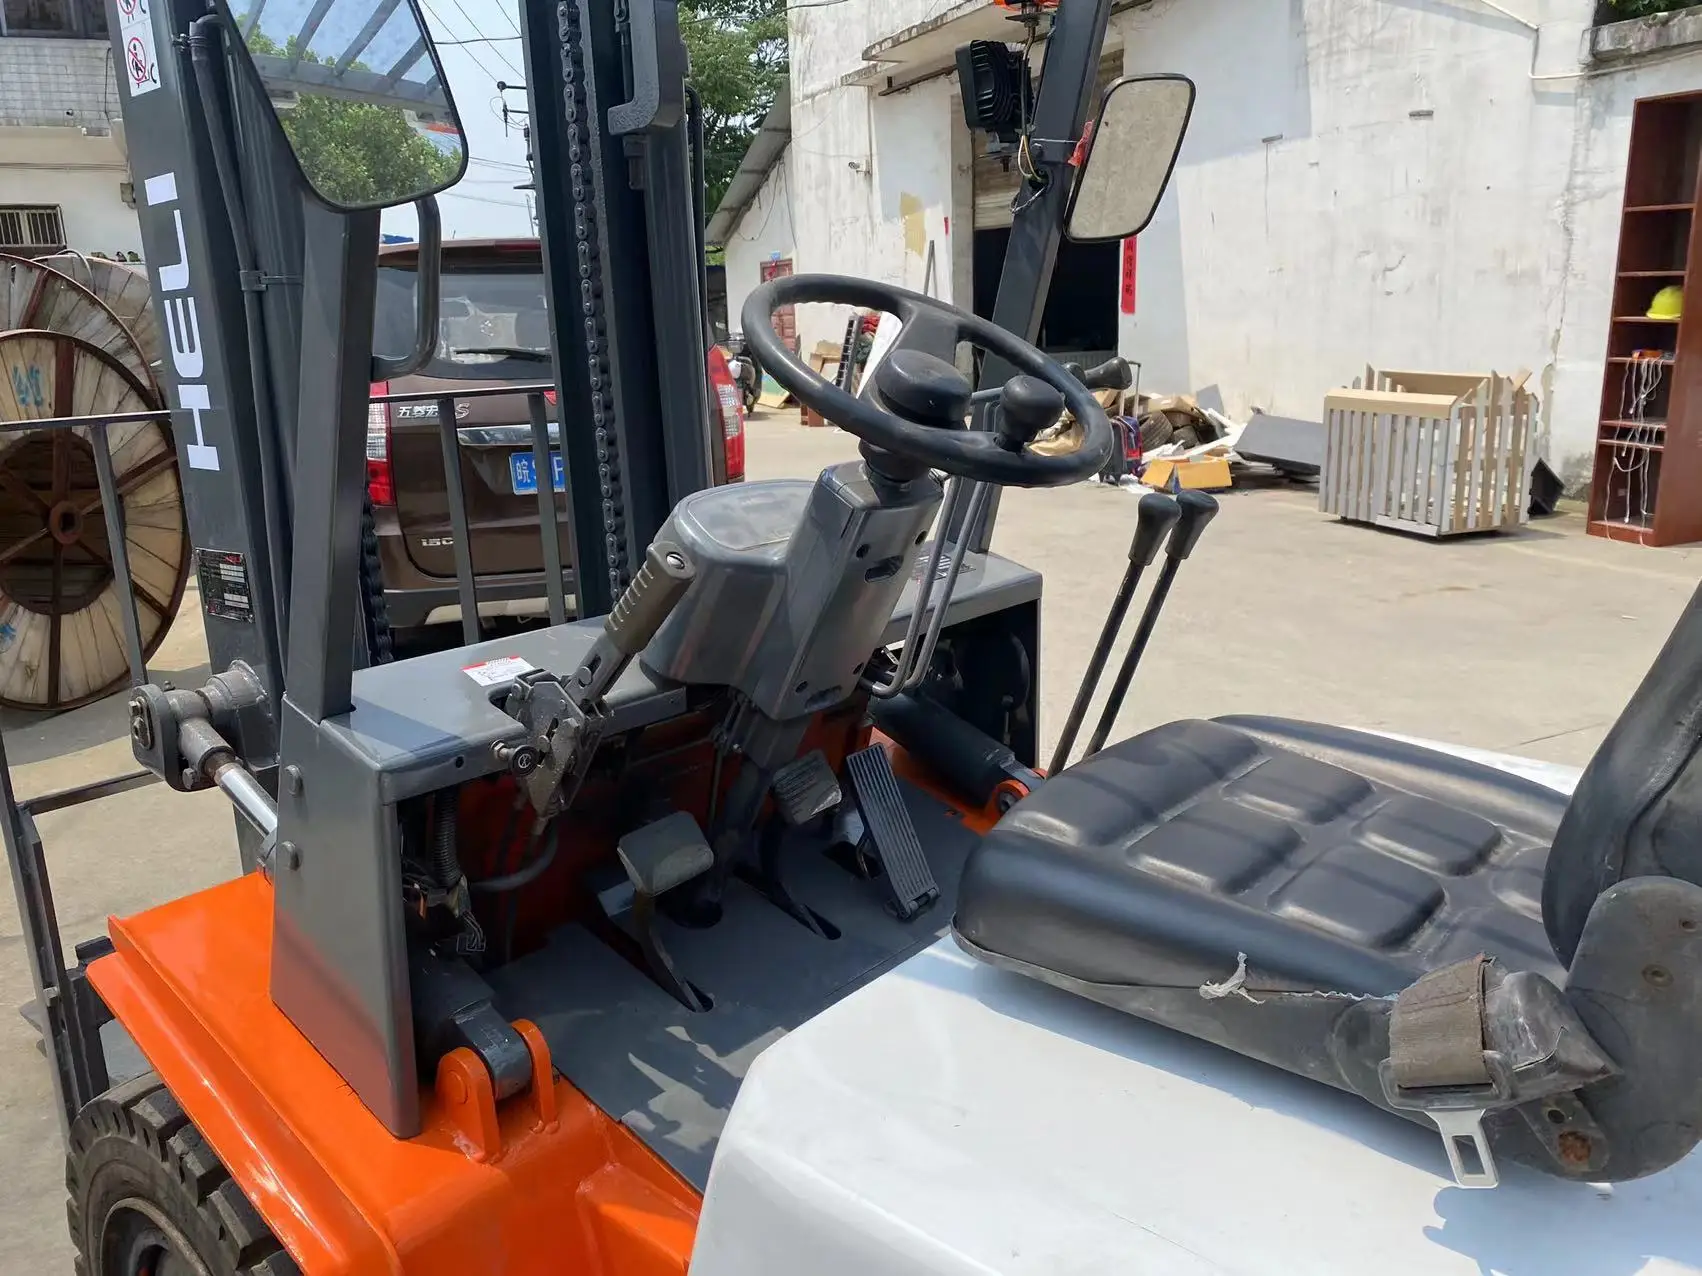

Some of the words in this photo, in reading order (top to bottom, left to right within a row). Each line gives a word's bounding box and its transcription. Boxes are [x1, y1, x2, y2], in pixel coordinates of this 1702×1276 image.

[144, 172, 220, 471] HELI
[397, 404, 439, 418] 五菱宏
